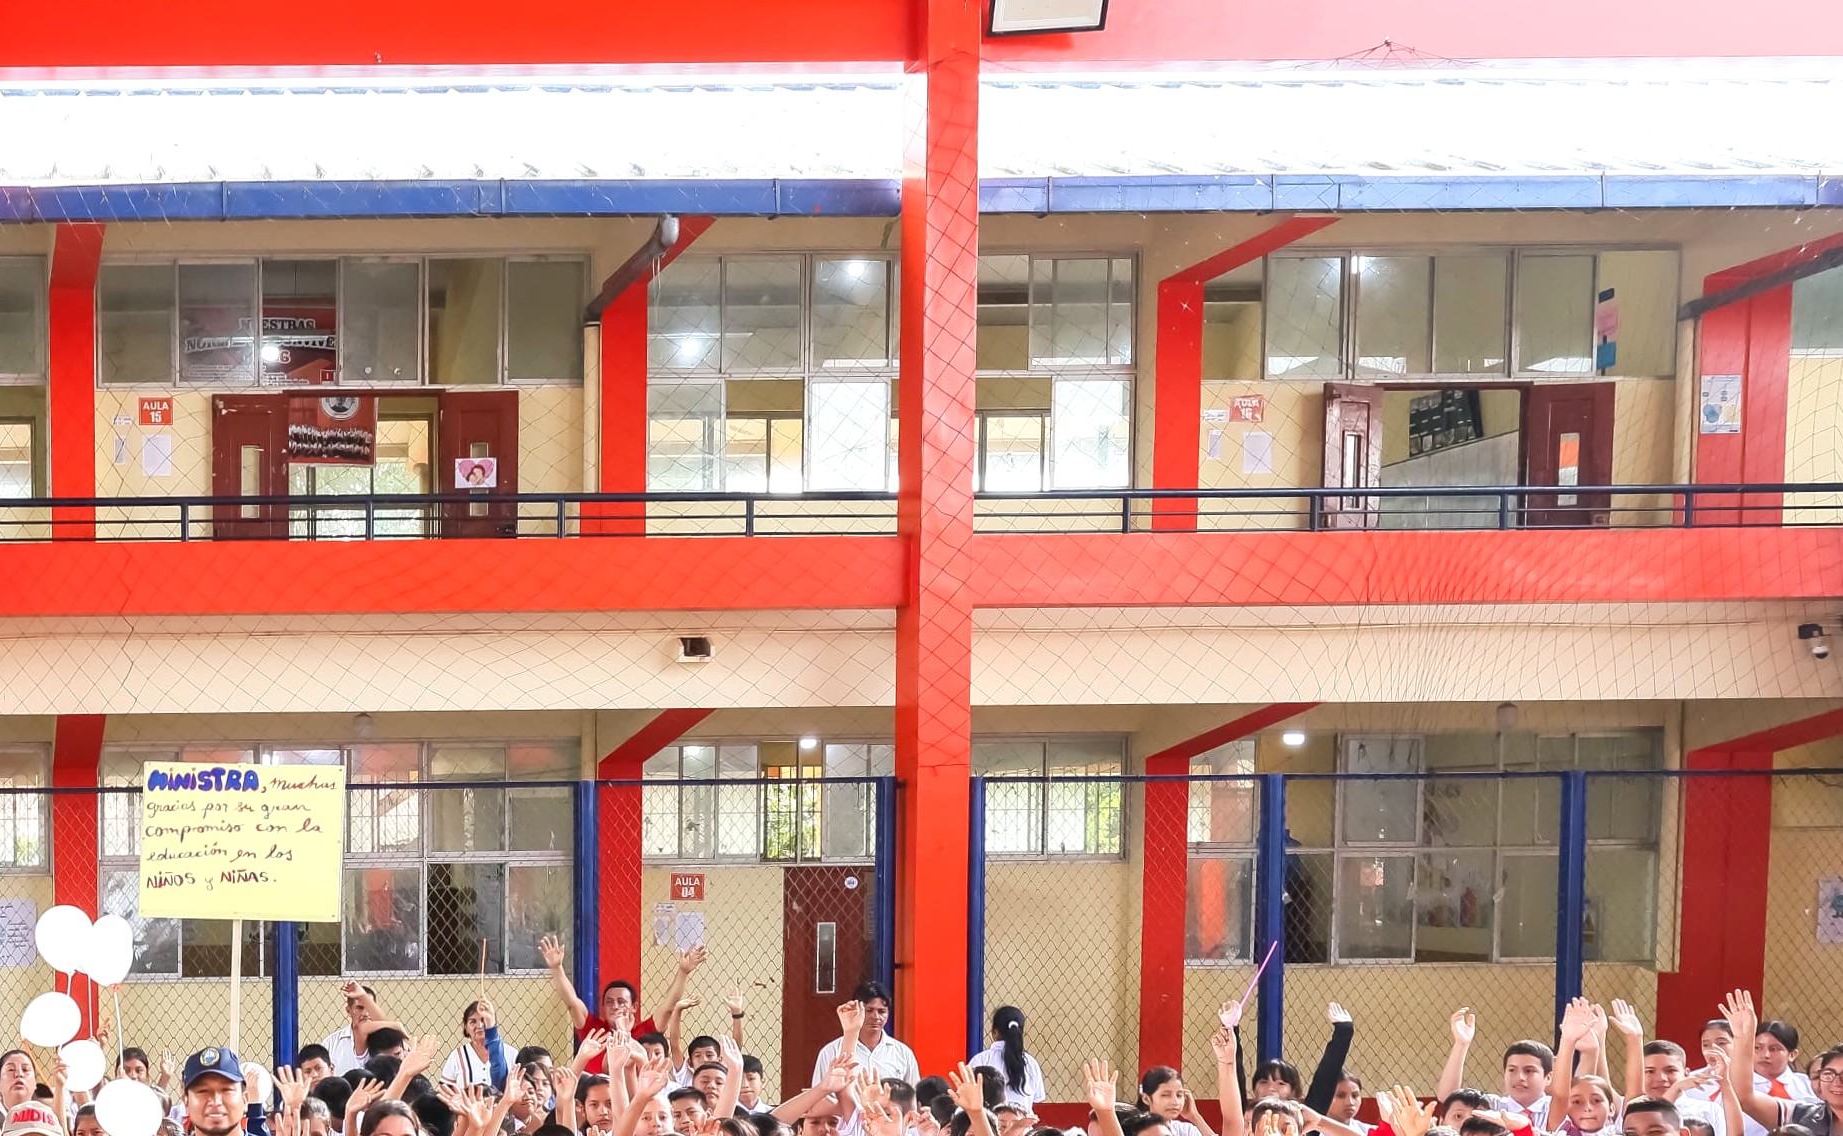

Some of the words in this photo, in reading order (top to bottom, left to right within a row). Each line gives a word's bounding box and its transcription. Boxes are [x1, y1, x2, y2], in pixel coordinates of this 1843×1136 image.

[240, 318, 315, 331] NESTRAS
[143, 402, 169, 411] AULA
[150, 410, 162, 423] 15
[147, 799, 196, 818] gracias
[260, 803, 311, 819] gran
[145, 820, 245, 843] compromiso
[255, 823, 288, 833] con
[295, 817, 324, 834] la
[146, 842, 228, 862] educación
[230, 849, 258, 863] en
[265, 843, 293, 861] los
[204, 875, 214, 891] y
[674, 877, 700, 886] AULA
[681, 886, 695, 898] 04
